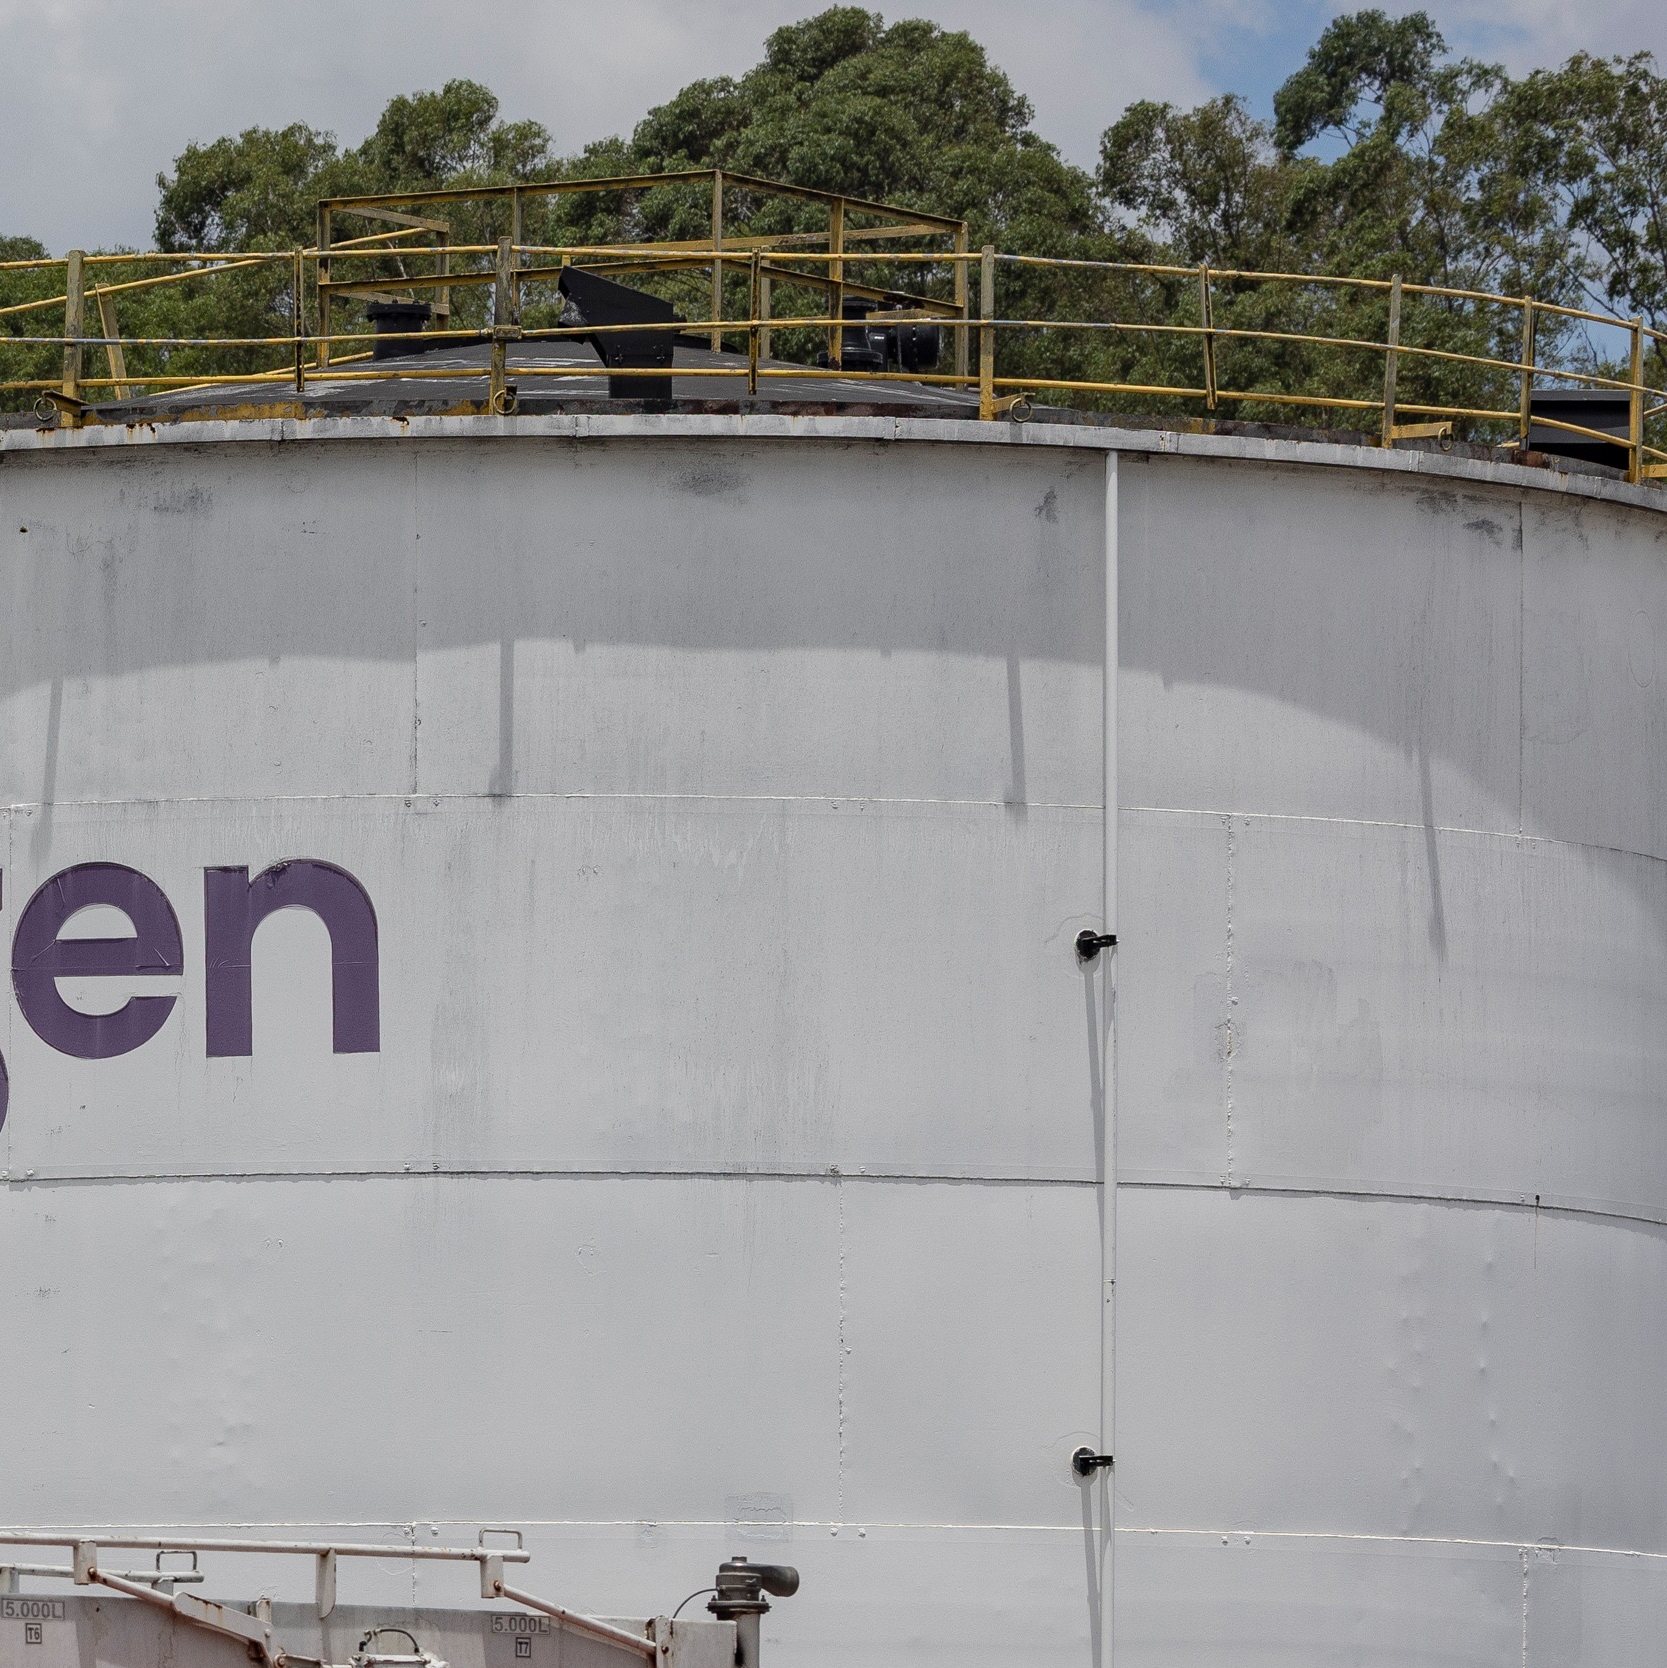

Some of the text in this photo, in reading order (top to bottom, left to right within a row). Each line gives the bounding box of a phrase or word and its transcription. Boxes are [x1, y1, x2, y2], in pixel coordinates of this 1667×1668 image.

[5, 1601, 63, 1618] 5.000L
[494, 1616, 548, 1633] 5.000L
[27, 1626, 40, 1641] T6
